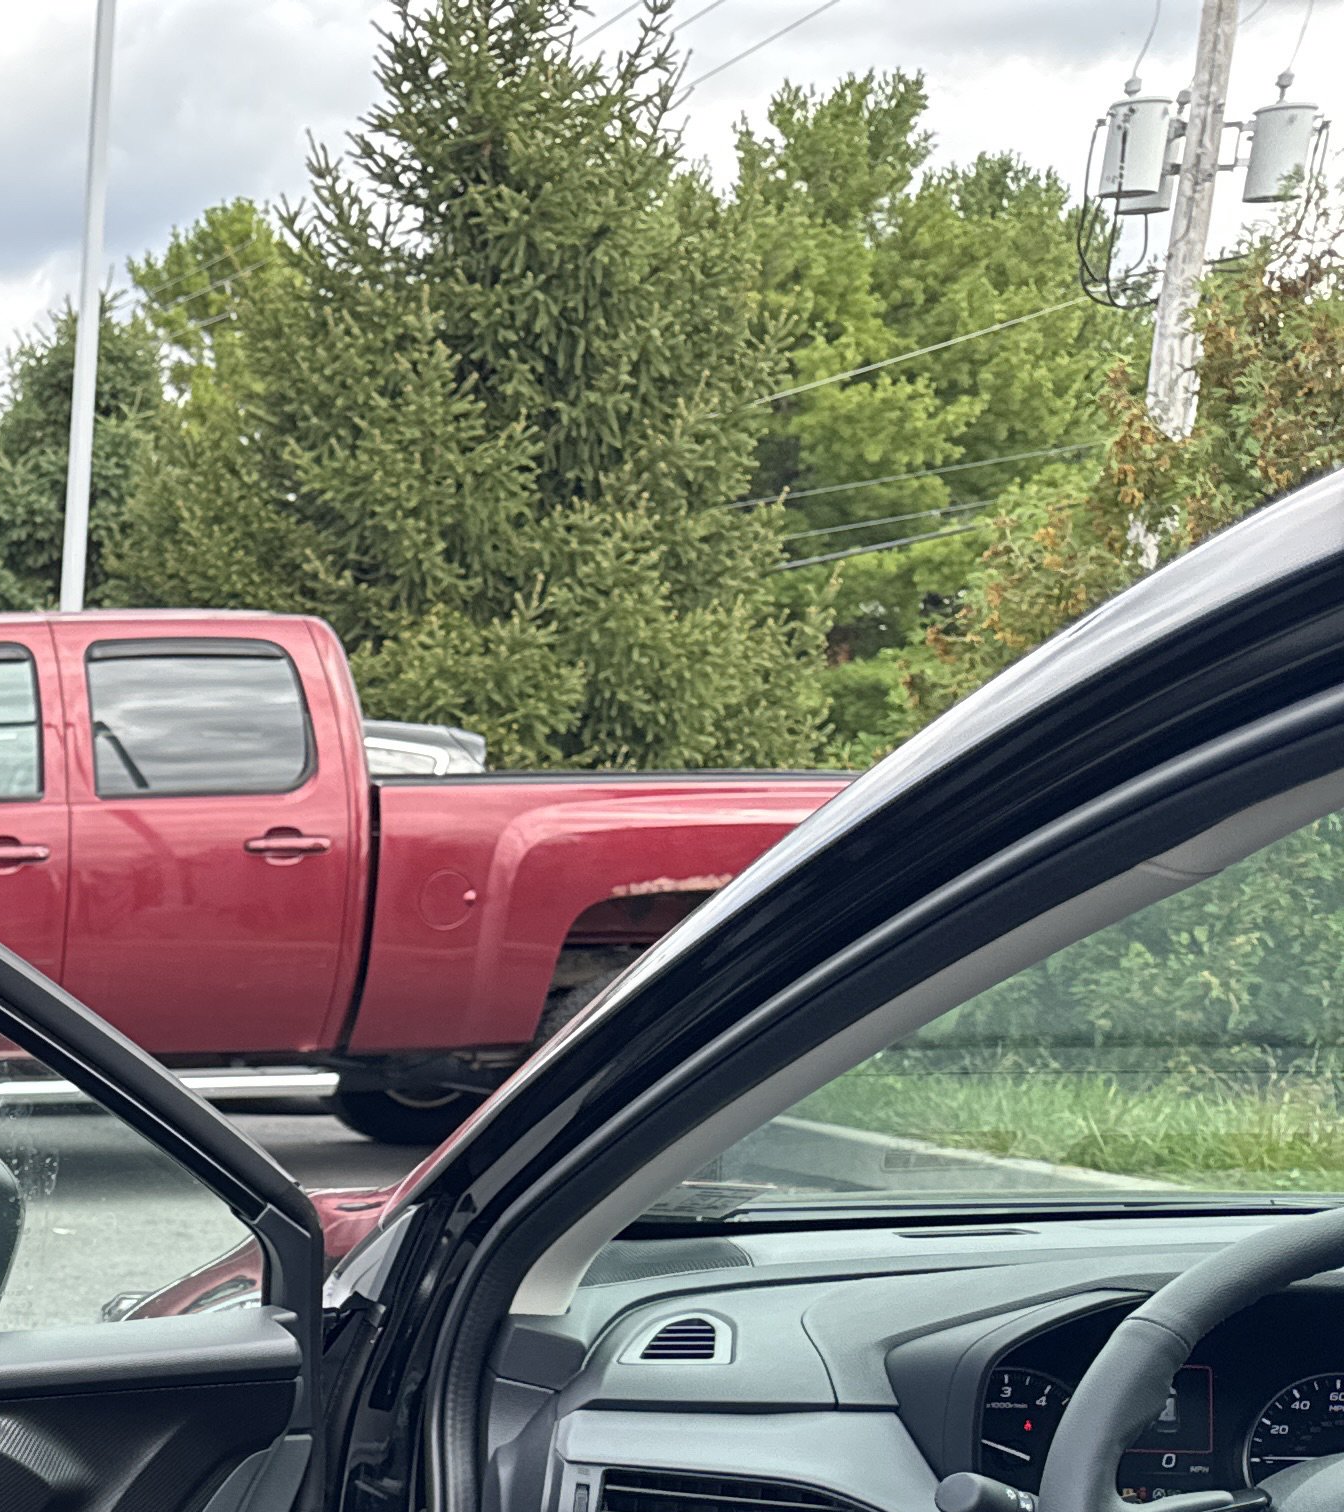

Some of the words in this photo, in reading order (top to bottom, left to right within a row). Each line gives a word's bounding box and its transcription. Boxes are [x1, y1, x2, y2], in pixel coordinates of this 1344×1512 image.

[1000, 1386, 1012, 1398] 3
[1035, 1395, 1048, 1407] 4
[1290, 1400, 1311, 1410] 40
[1270, 1424, 1289, 1435] 20
[1162, 1453, 1176, 1469] 0
